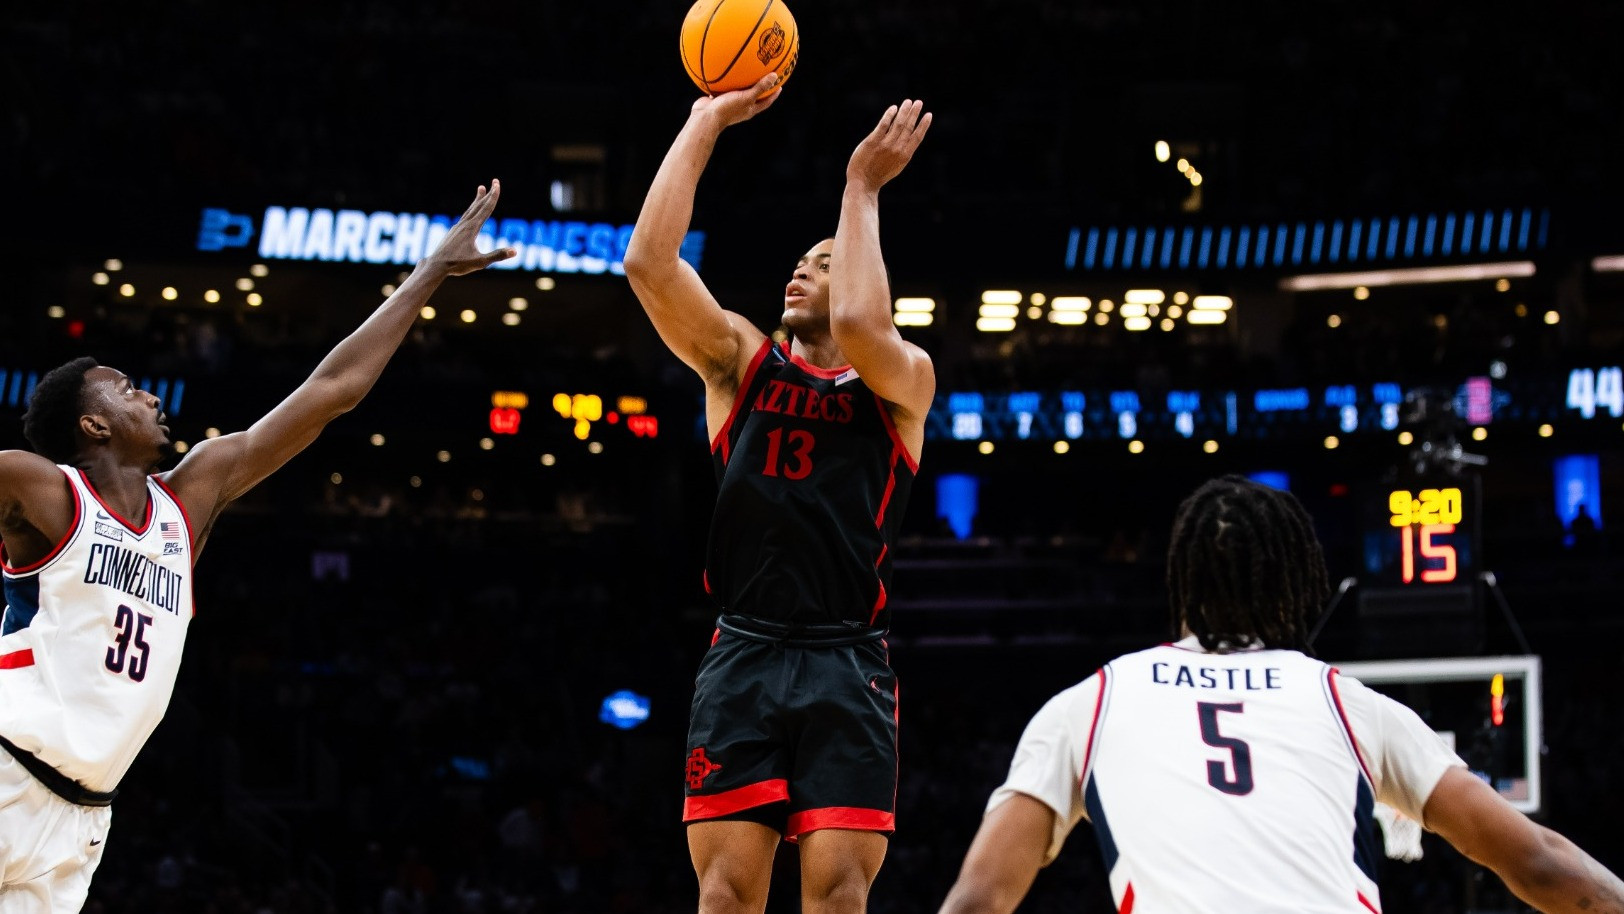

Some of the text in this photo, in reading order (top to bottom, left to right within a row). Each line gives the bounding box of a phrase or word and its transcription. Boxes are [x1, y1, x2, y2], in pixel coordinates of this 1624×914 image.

[258, 206, 428, 265] MARCH
[751, 379, 854, 424] AZTECS
[1567, 366, 1622, 420] 44
[762, 426, 816, 480] 13
[1389, 488, 1462, 527] 9:20
[163, 547, 183, 555] EAST
[1401, 523, 1457, 584] 15
[84, 543, 182, 616] CONNECTICUT
[105, 604, 153, 683] 35
[1152, 662, 1282, 691] CASTLE
[1197, 701, 1254, 796] 5
